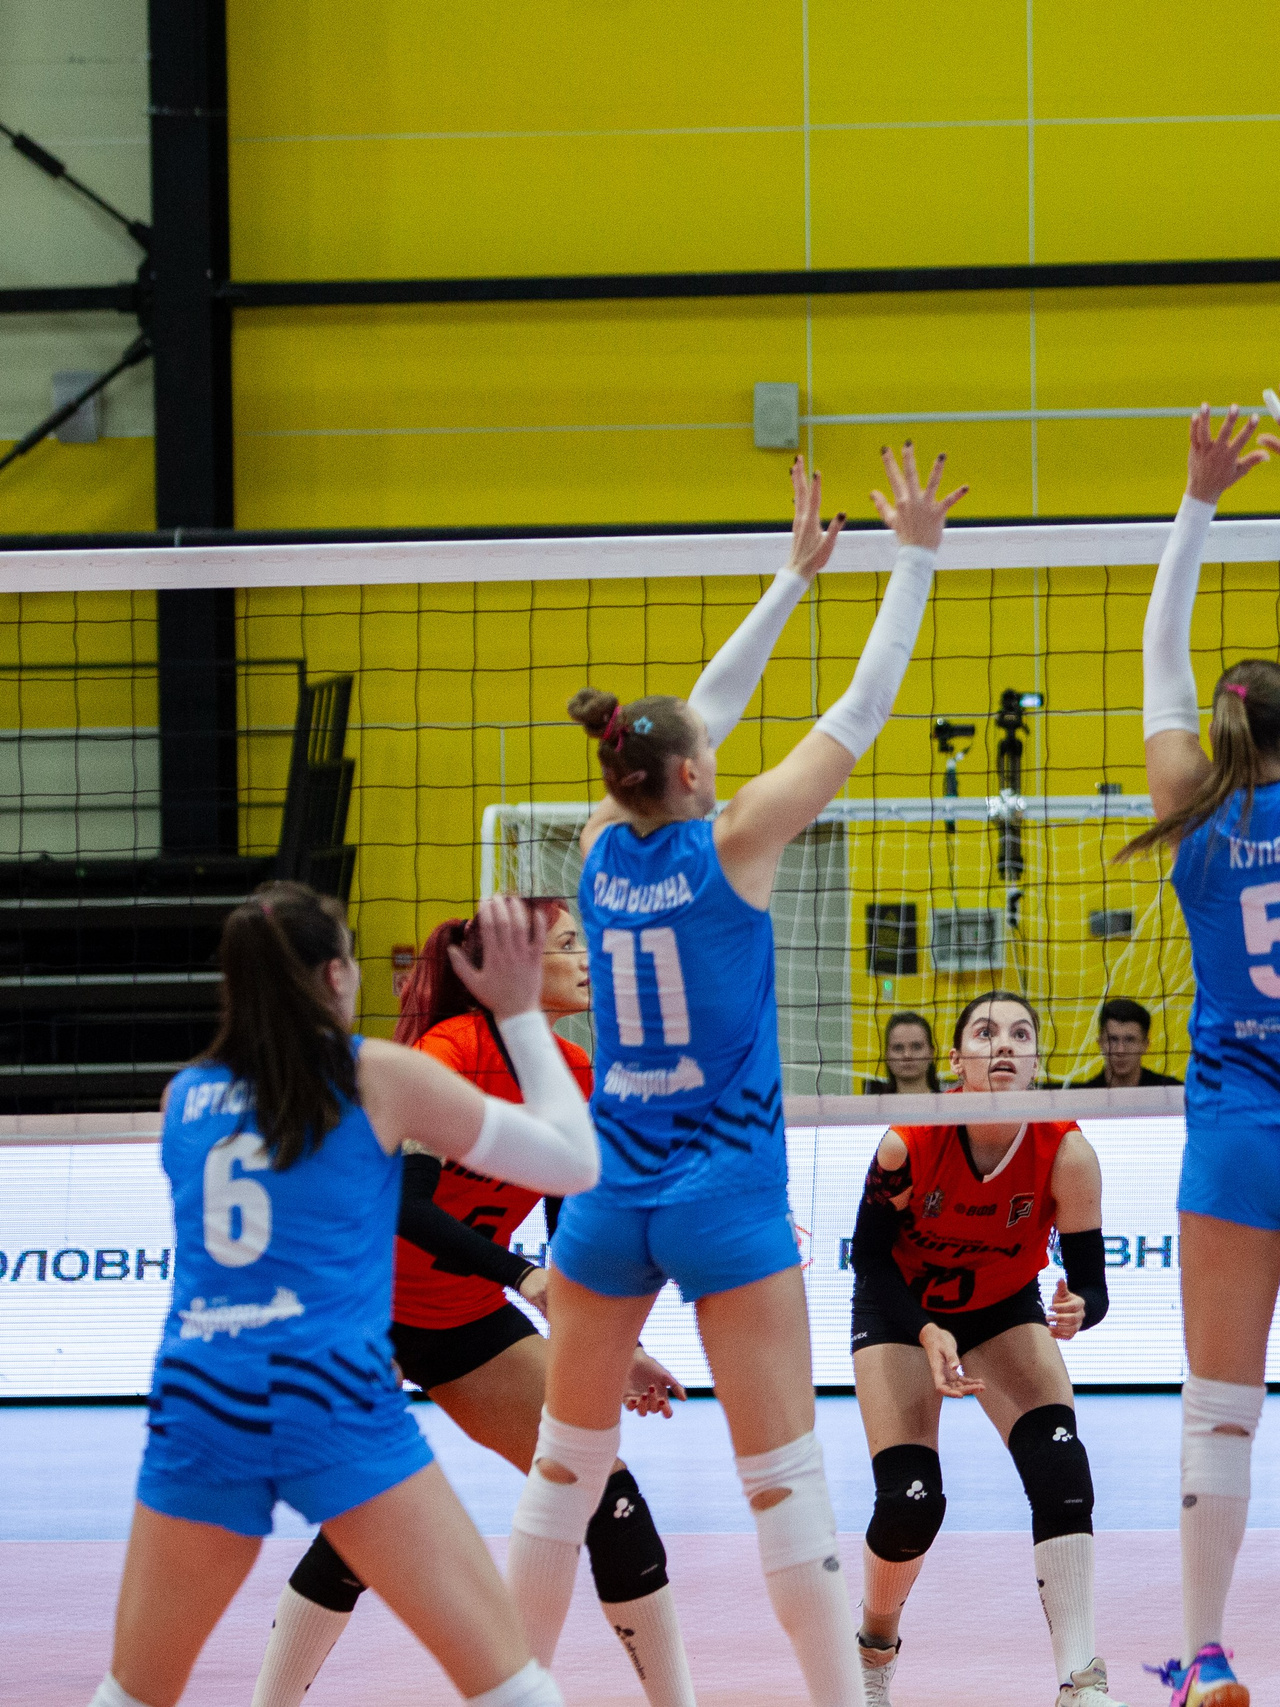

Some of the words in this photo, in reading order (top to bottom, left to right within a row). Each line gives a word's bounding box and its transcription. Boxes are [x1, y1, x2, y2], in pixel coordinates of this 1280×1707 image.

[602, 927, 691, 1046] 11
[203, 1132, 272, 1268] 6
[0, 1249, 171, 1281] ЛОВН
